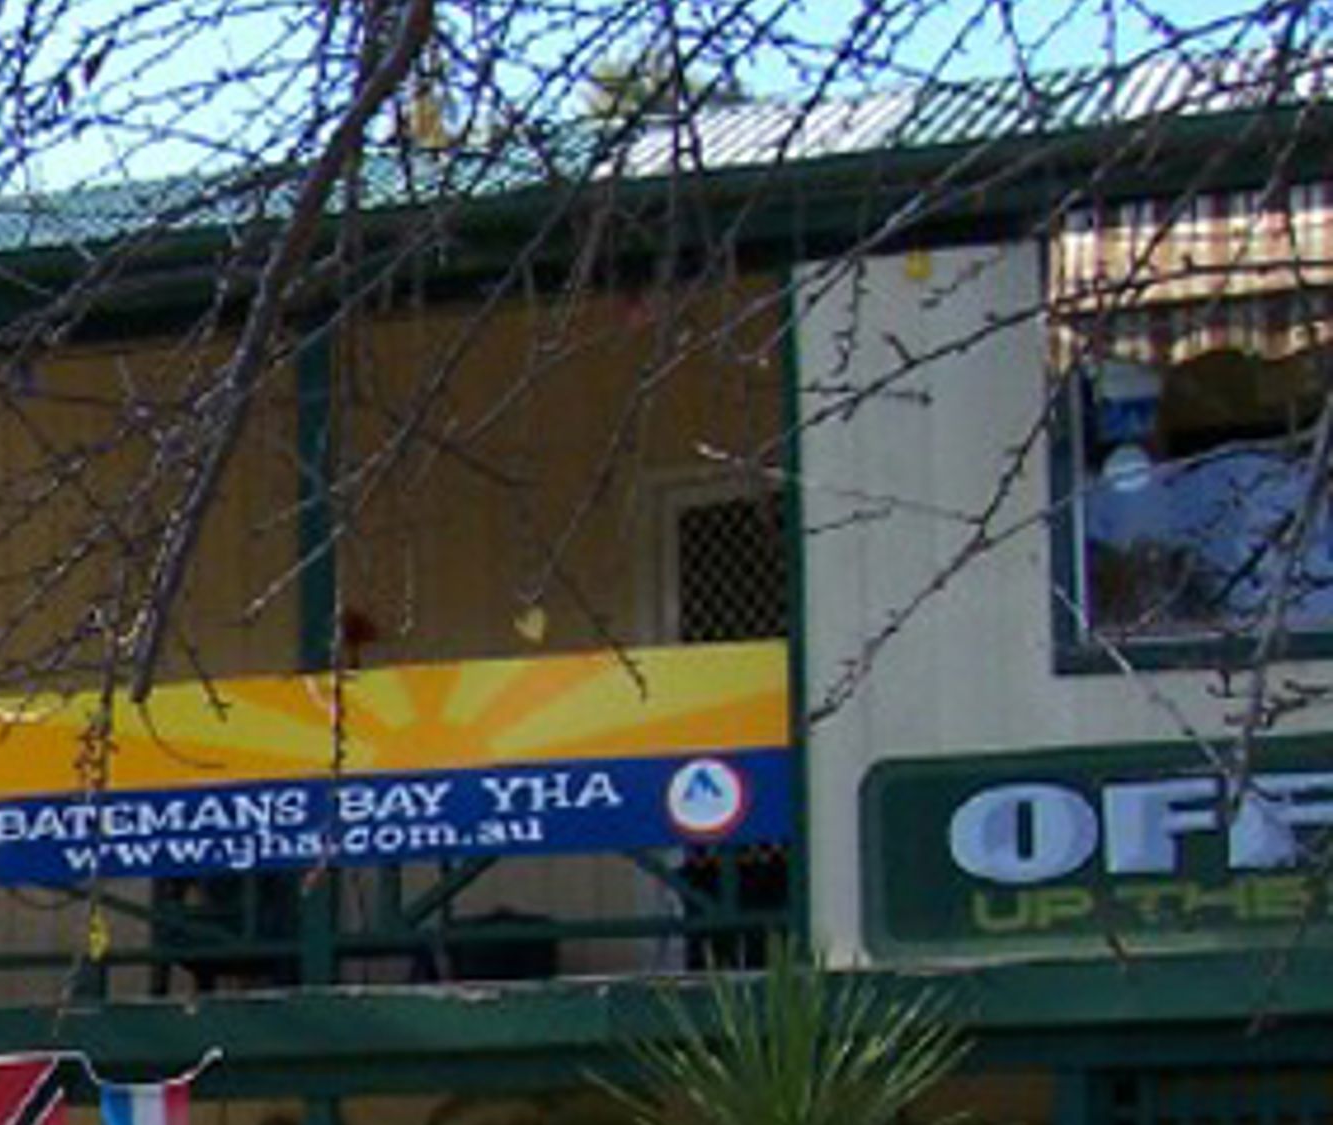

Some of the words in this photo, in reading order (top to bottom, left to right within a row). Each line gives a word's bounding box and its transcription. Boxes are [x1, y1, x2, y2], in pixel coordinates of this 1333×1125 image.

[338, 783, 451, 821] BAY
[481, 772, 623, 813] YHA
[63, 816, 543, 870] www.yha.com.au
[973, 886, 1094, 930] UP
